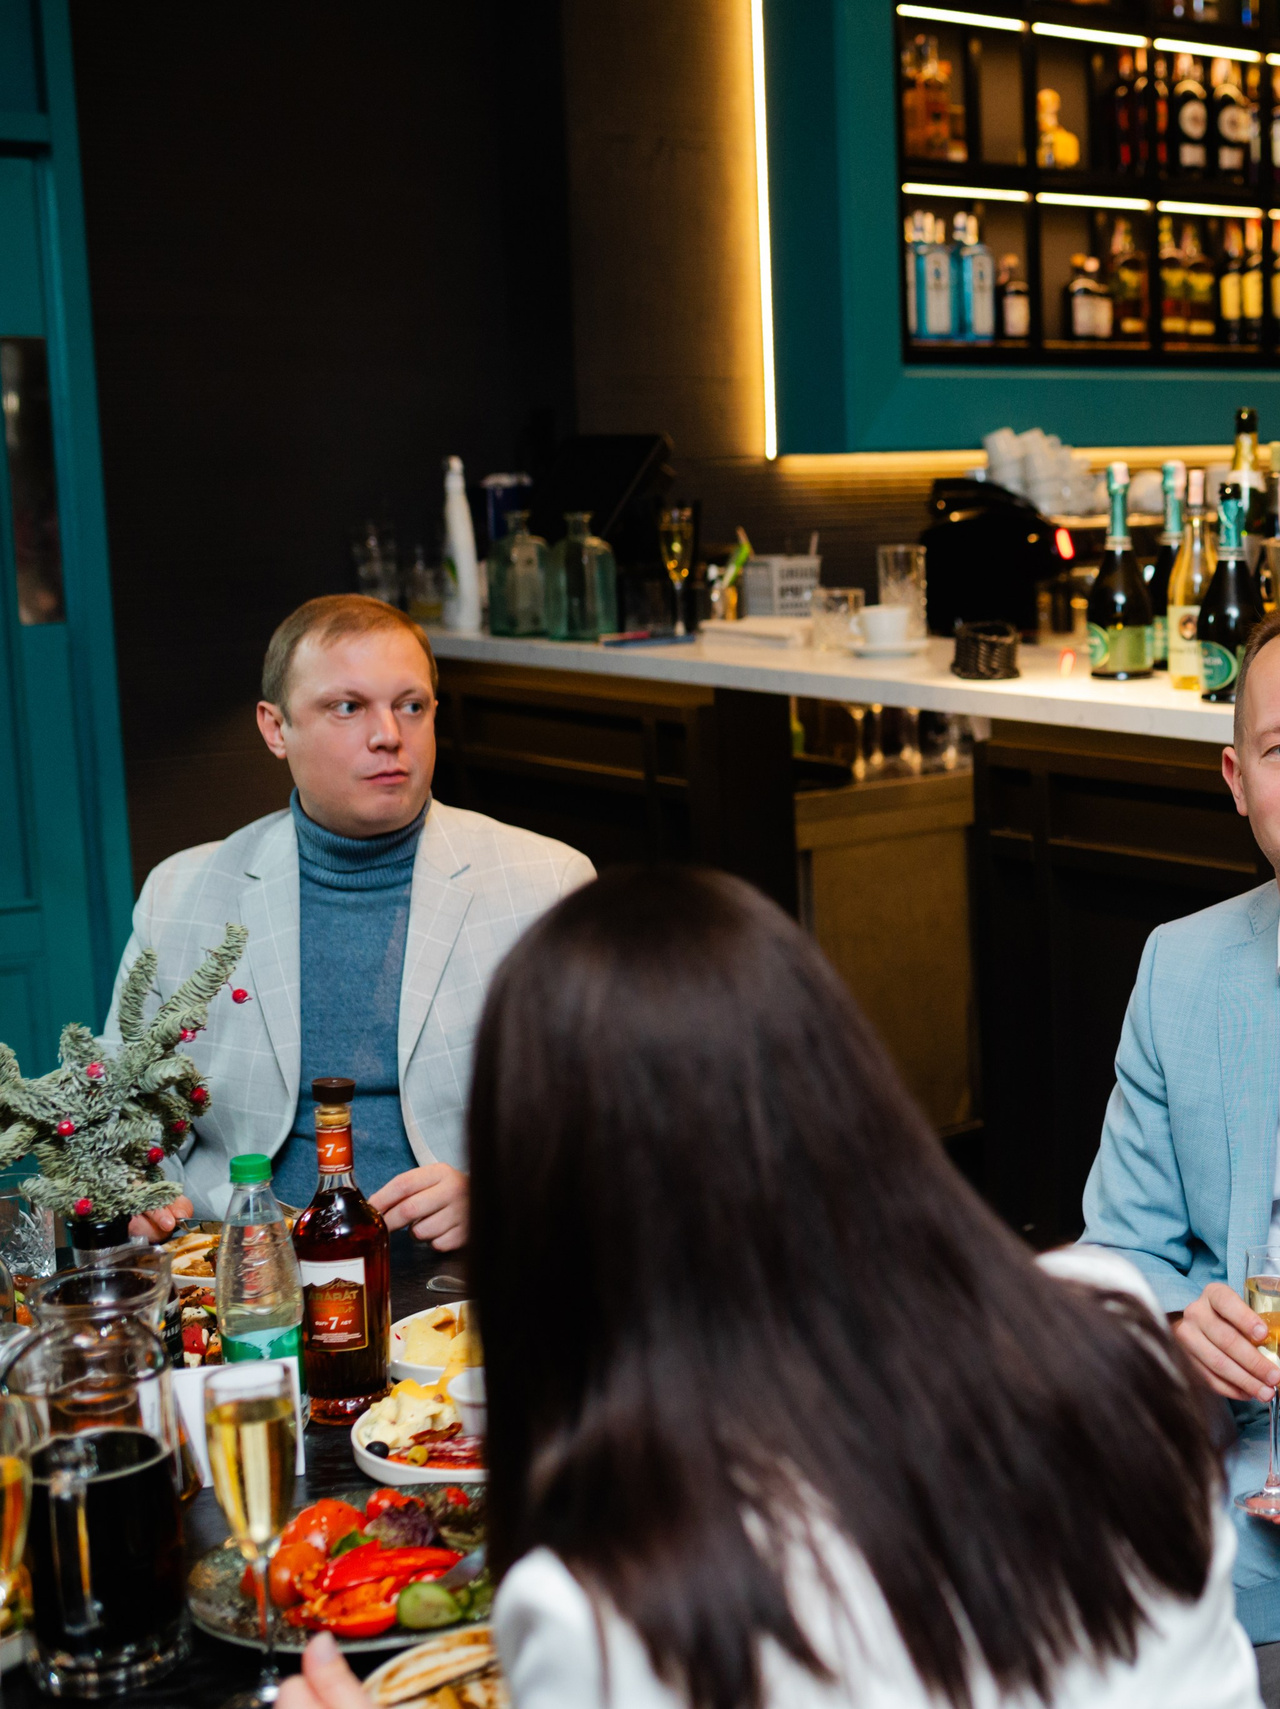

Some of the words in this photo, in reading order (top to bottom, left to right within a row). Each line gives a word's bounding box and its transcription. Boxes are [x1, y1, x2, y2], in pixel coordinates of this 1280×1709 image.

[325, 1144, 335, 1157] 7
[308, 1290, 359, 1301] ARARAT
[329, 1317, 339, 1330] 7
